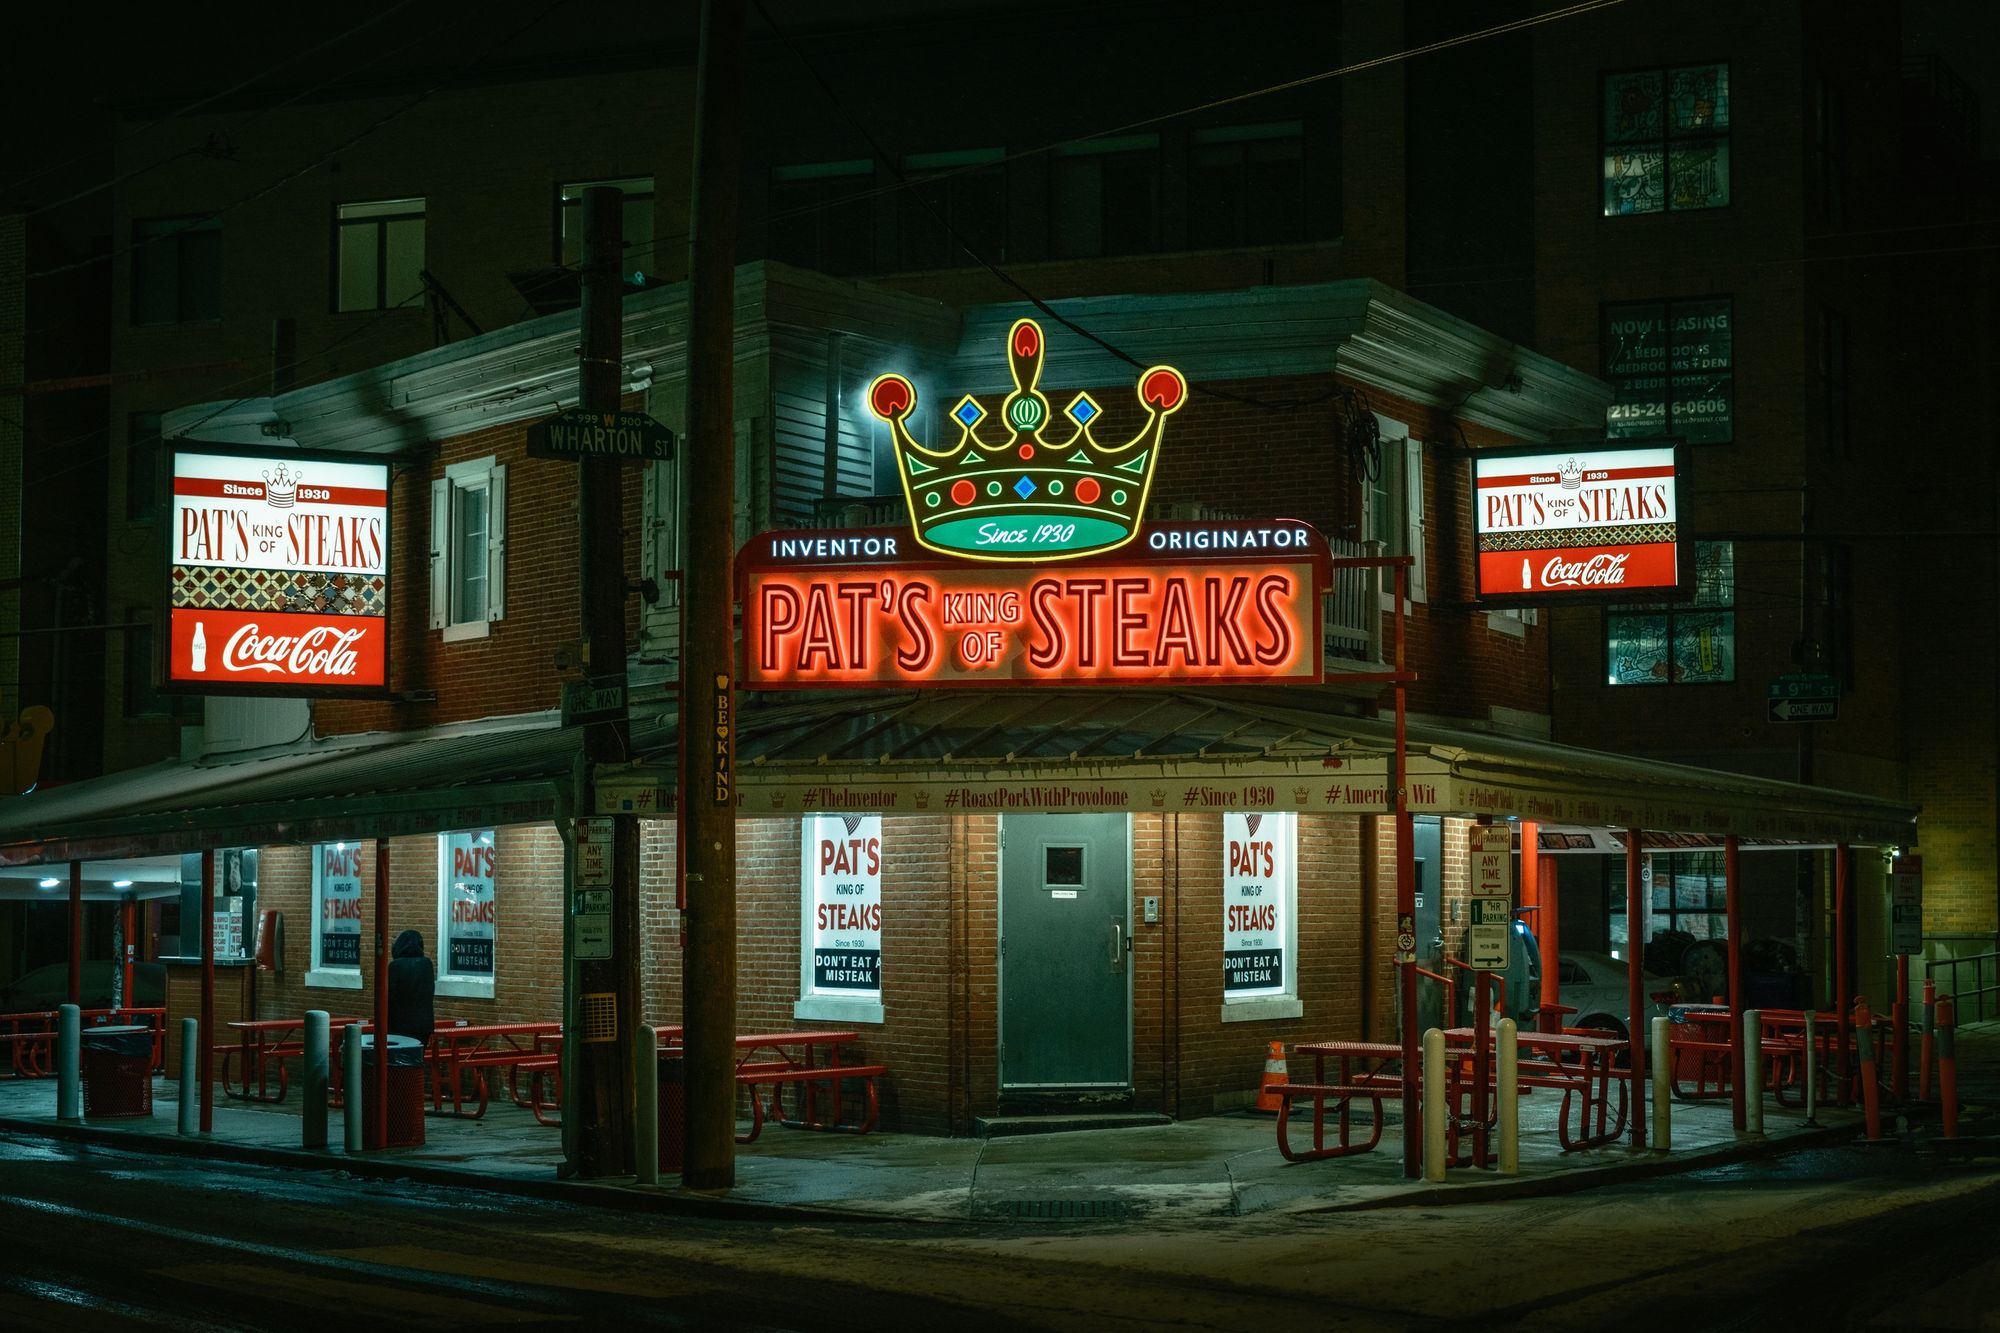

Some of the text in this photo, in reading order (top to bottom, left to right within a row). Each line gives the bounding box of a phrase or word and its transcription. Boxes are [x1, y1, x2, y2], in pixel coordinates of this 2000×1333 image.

[1611, 315, 1727, 335] NOW LASING
[1702, 357, 1727, 368] DEN
[1611, 399, 1727, 418] 215-246-0606
[577, 413, 641, 427] 999 W 900
[550, 425, 669, 456] WHARTON ST
[1530, 472, 1608, 484] Since 1930
[223, 483, 330, 500] Since 1930
[1486, 484, 1668, 528] PAT'S KING OF STEAKS
[180, 507, 382, 570] PAT'S KING OF STEAKS
[975, 523, 1075, 545] Since 1930
[1150, 529, 1308, 550] ORIGINATOR
[772, 538, 897, 557] INVENTOR
[1541, 553, 1630, 587] Coca-Cola
[761, 574, 1291, 672] PAT'S KING OF STEAKS
[222, 623, 367, 676] Coca-Cola
[1821, 686, 1836, 696] ST
[572, 689, 618, 712] ONE WAY
[1790, 703, 1831, 714] ONE WAY
[802, 788, 897, 808] #TheInventor
[944, 786, 1128, 809] #RoastPorkWithProvolone
[1183, 786, 1274, 807] #Since 1930
[1413, 784, 1436, 804] Wit
[577, 827, 587, 839] NO
[1472, 833, 1508, 847] NO PARKING
[587, 846, 602, 856] ANY
[821, 838, 879, 876] PAT'S
[326, 848, 361, 877] PAT'S
[454, 847, 495, 878] PAT'S
[586, 858, 603, 869] TIME
[1230, 841, 1274, 878] PAT'S
[1482, 856, 1499, 866] ANY
[1481, 869, 1500, 879] TIME
[592, 892, 603, 901] HR
[836, 884, 864, 895] KING OF
[1241, 886, 1262, 896] KING OF
[324, 898, 362, 920] STEAKS
[453, 900, 495, 923] STEAKS
[585, 904, 610, 913] PARKING
[1473, 903, 1500, 922] 1 HR
[818, 903, 881, 932] STEAKS
[1228, 904, 1275, 932] STEAKS
[1483, 913, 1507, 922] PARKING
[343, 939, 356, 948] EAT
[474, 945, 488, 954] EAT
[834, 939, 864, 948] Since 1930
[1241, 939, 1253, 947] Since
[328, 949, 357, 960] MISTEAK
[457, 955, 488, 967] MISTEAK
[816, 955, 847, 967] DON'T
[851, 956, 872, 968] EAT
[1225, 955, 1279, 969] DON'T EAT A
[825, 969, 872, 982] MISTEAK
[1233, 970, 1271, 983] MISTEAK
